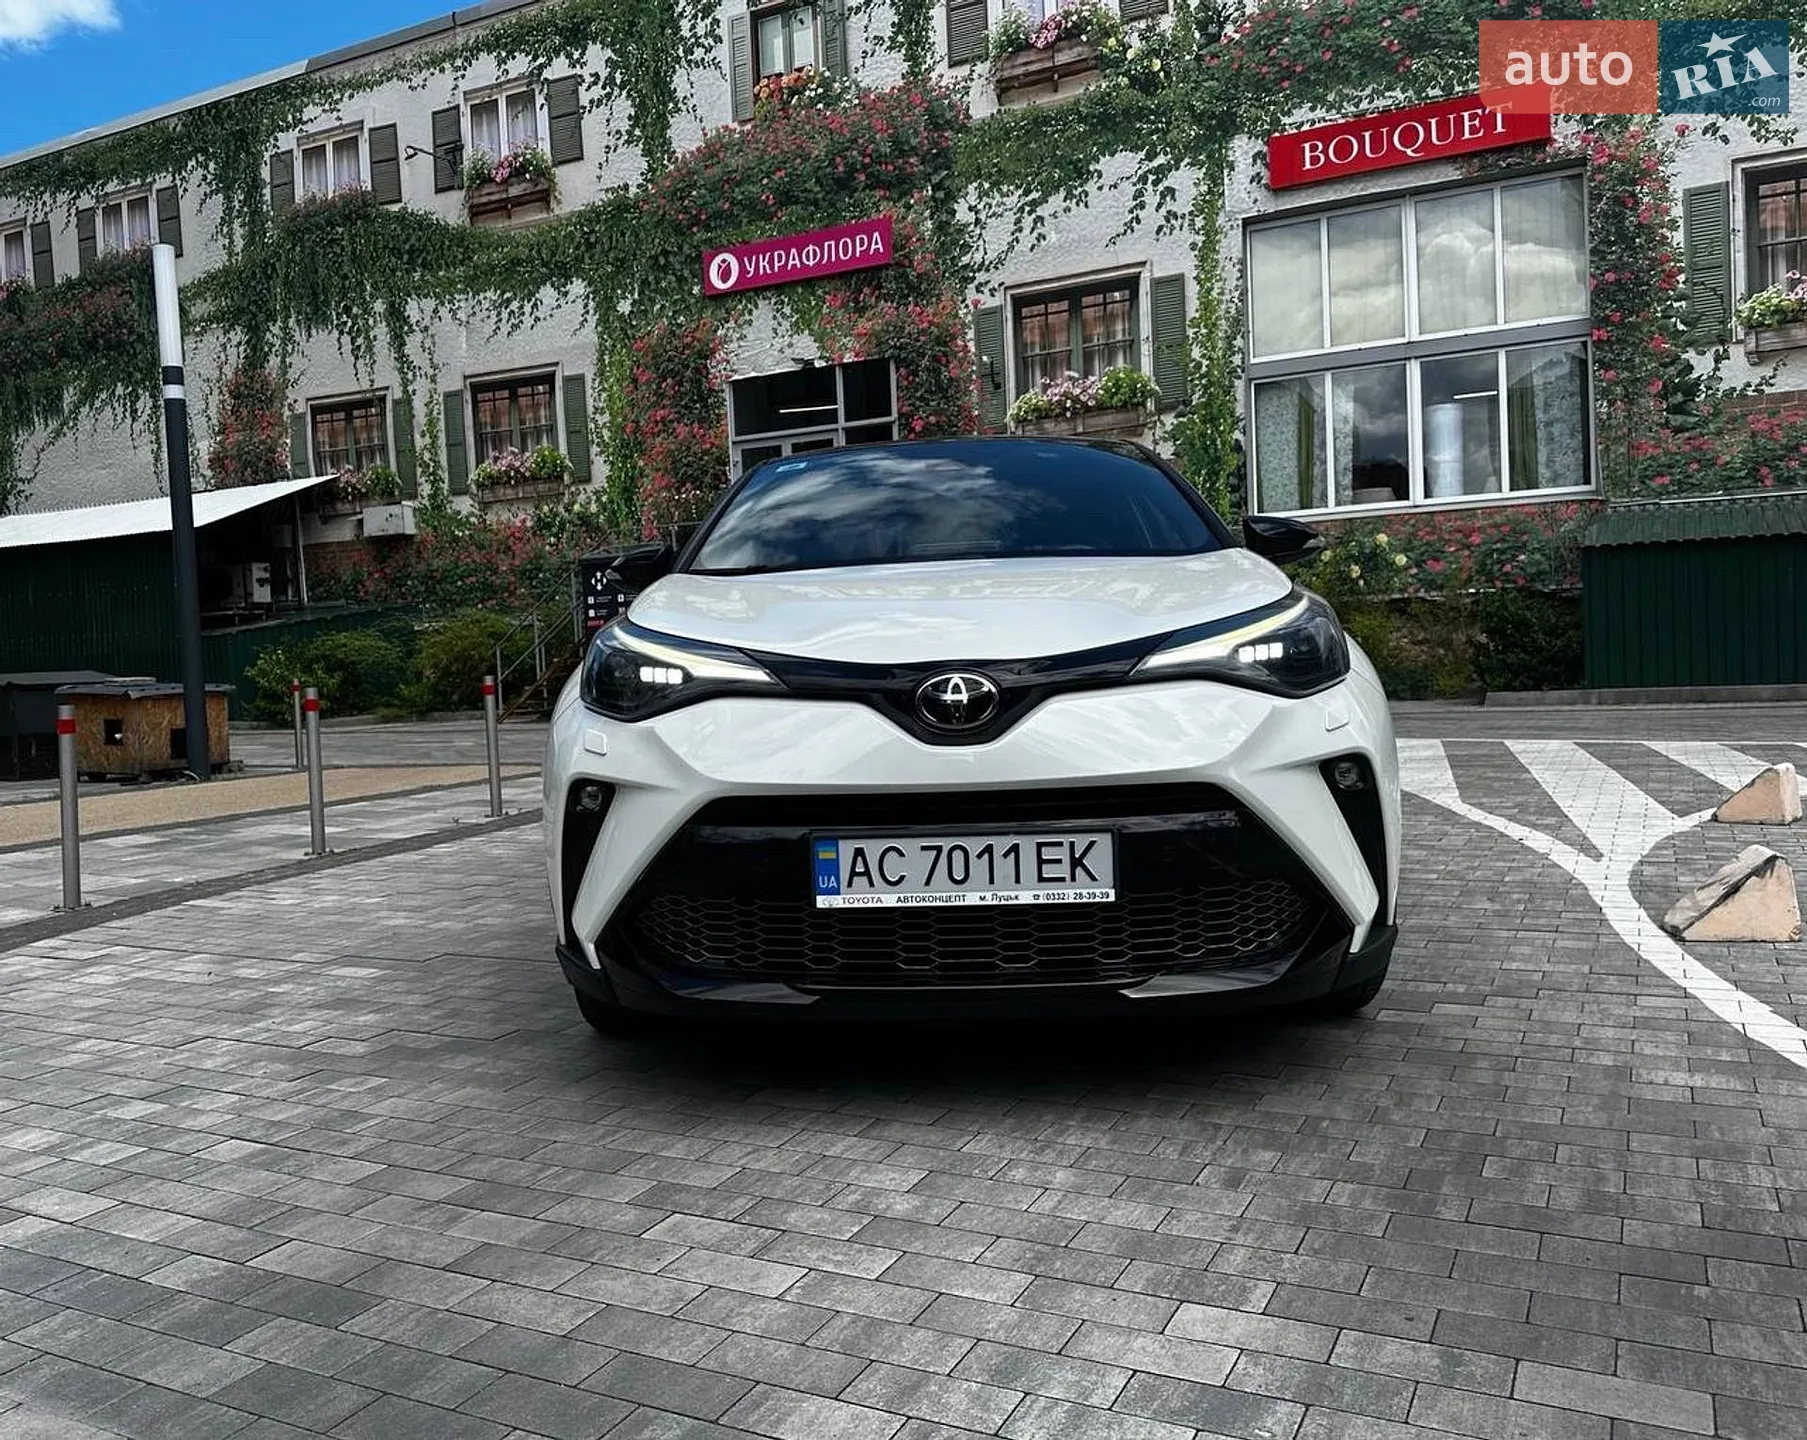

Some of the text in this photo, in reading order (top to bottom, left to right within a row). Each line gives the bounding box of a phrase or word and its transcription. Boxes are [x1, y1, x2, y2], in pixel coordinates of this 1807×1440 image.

[1300, 100, 1513, 171] BOUQUET
[743, 231, 884, 279] УКРАФЛОРА
[819, 875, 838, 889] UA
[846, 839, 1099, 889] AC 7011 EK
[841, 896, 884, 905] TOYOTA
[896, 893, 967, 904] АВТОКОНЦЕПТ
[1073, 890, 1110, 901] 28-39-39
